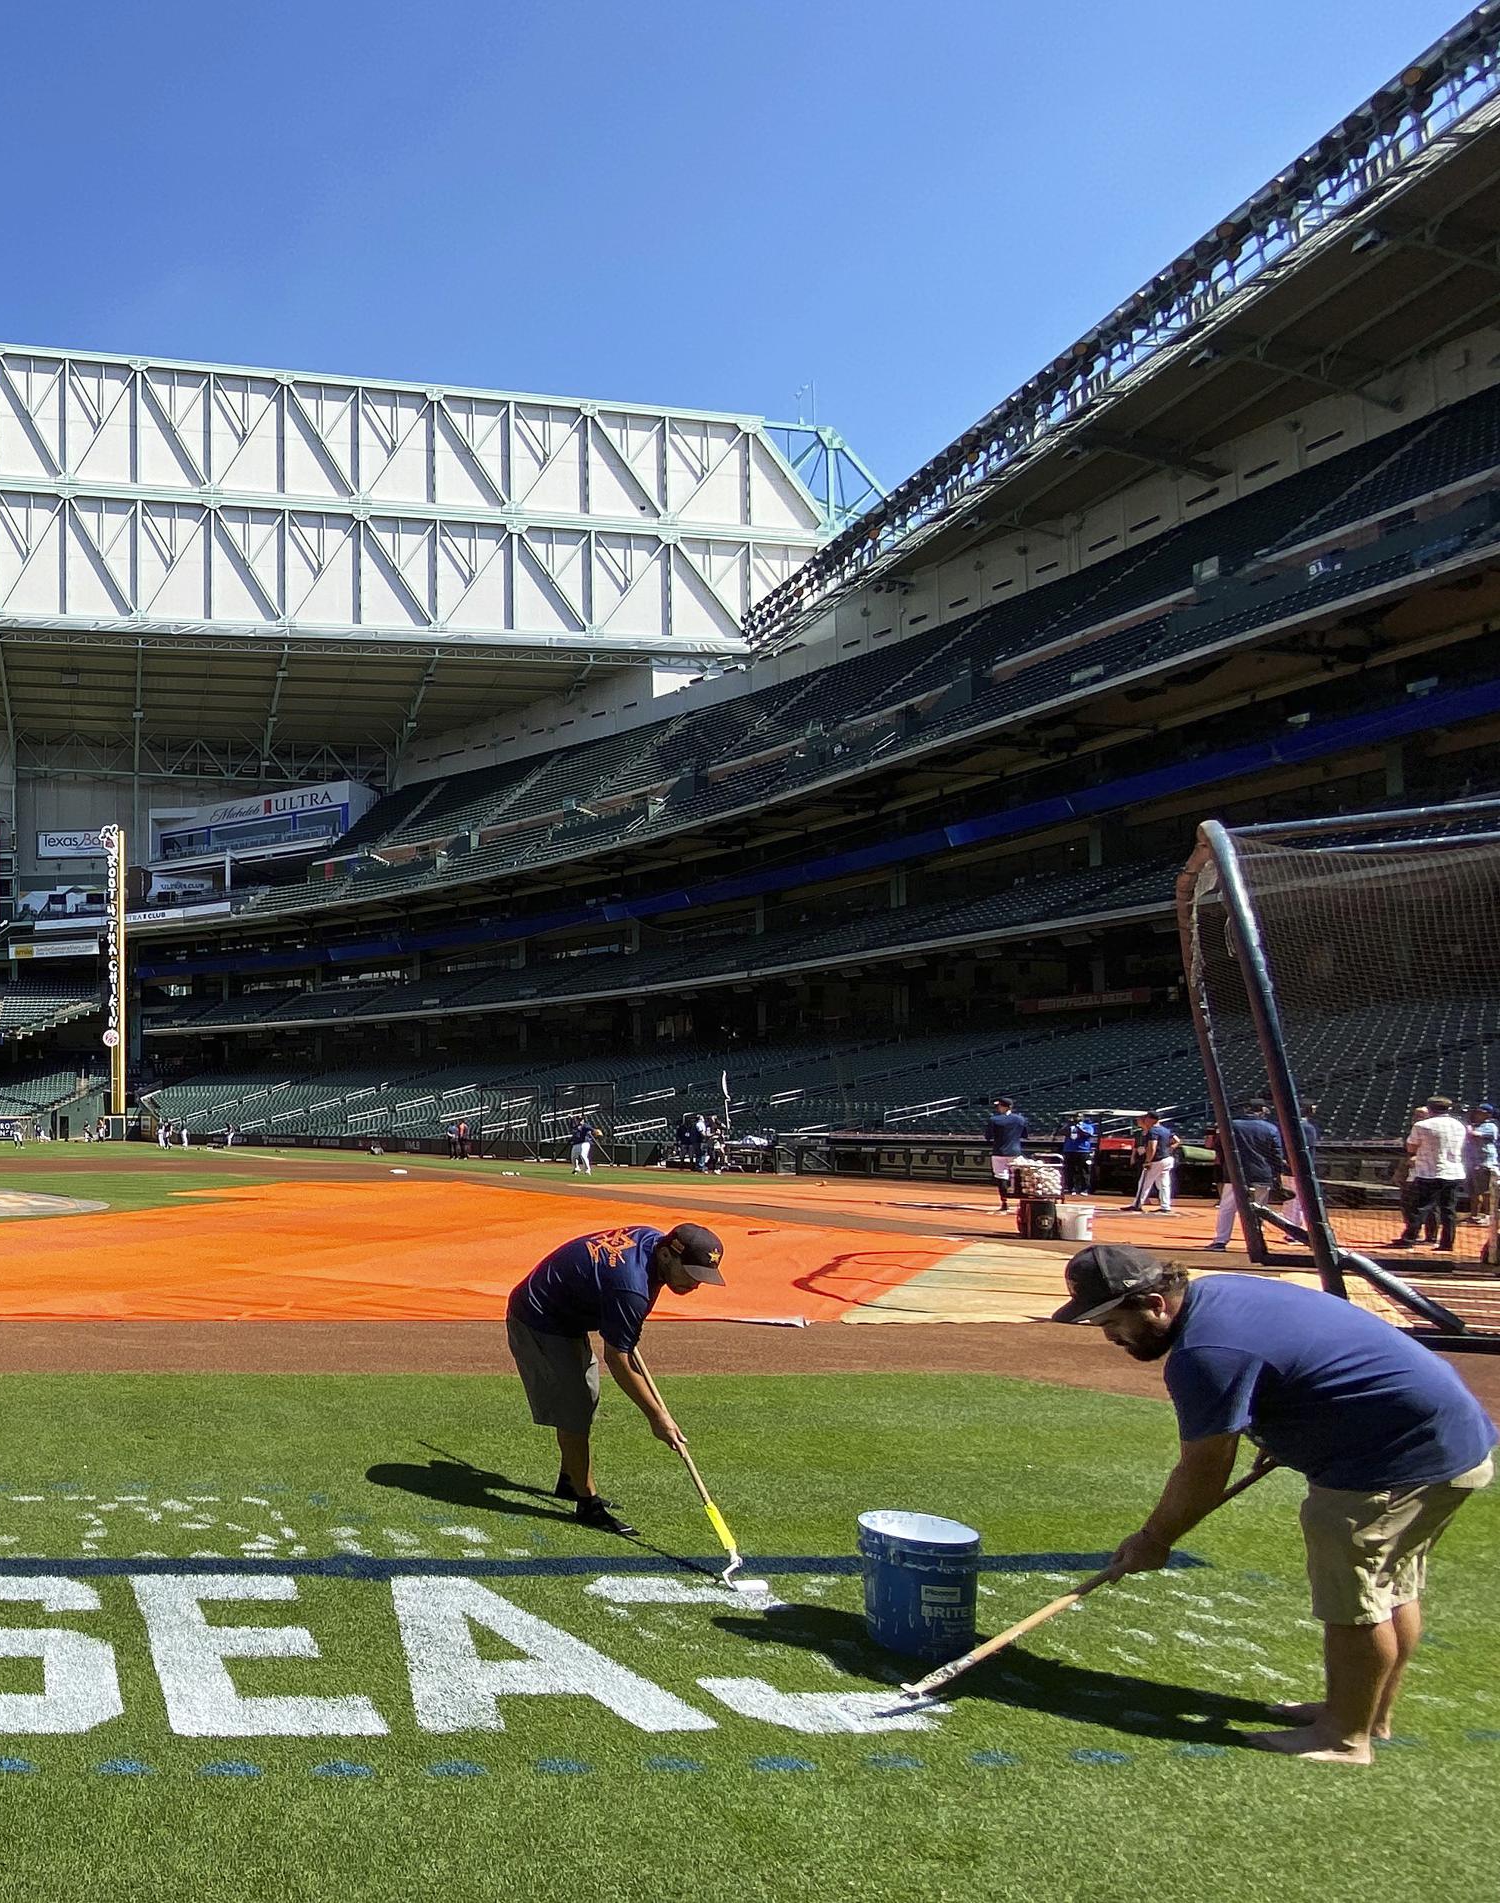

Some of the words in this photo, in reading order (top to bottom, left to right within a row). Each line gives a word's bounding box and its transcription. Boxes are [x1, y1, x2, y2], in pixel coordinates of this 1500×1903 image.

[210, 804, 261, 824] Michelob
[274, 791, 332, 812] ULTRA
[43, 834, 78, 847] Texas
[107, 855, 118, 901] ROOT
[107, 921, 117, 956] THA
[108, 960, 118, 1028] CHIKIN
